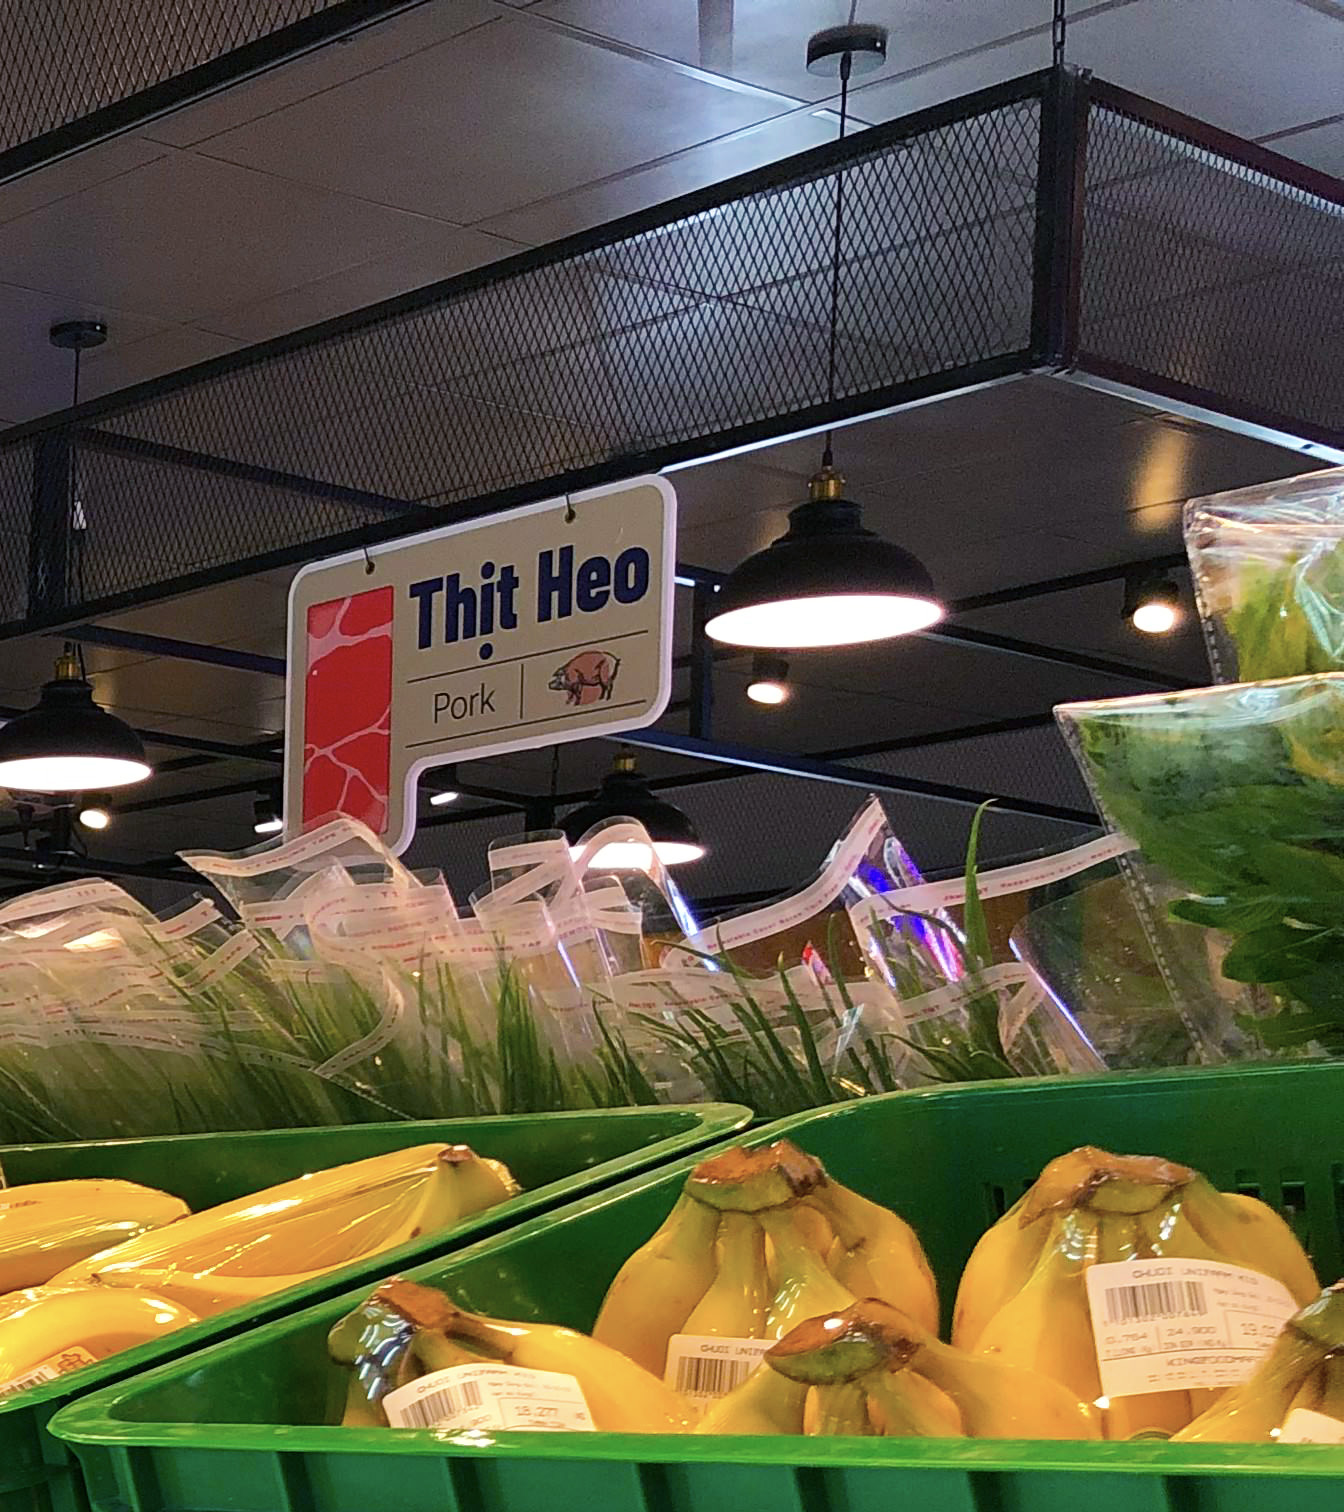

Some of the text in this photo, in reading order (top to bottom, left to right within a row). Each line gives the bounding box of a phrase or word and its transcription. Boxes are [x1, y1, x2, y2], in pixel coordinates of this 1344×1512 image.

[409, 545, 650, 660] Thịt Heo
[434, 683, 496, 723] Pork
